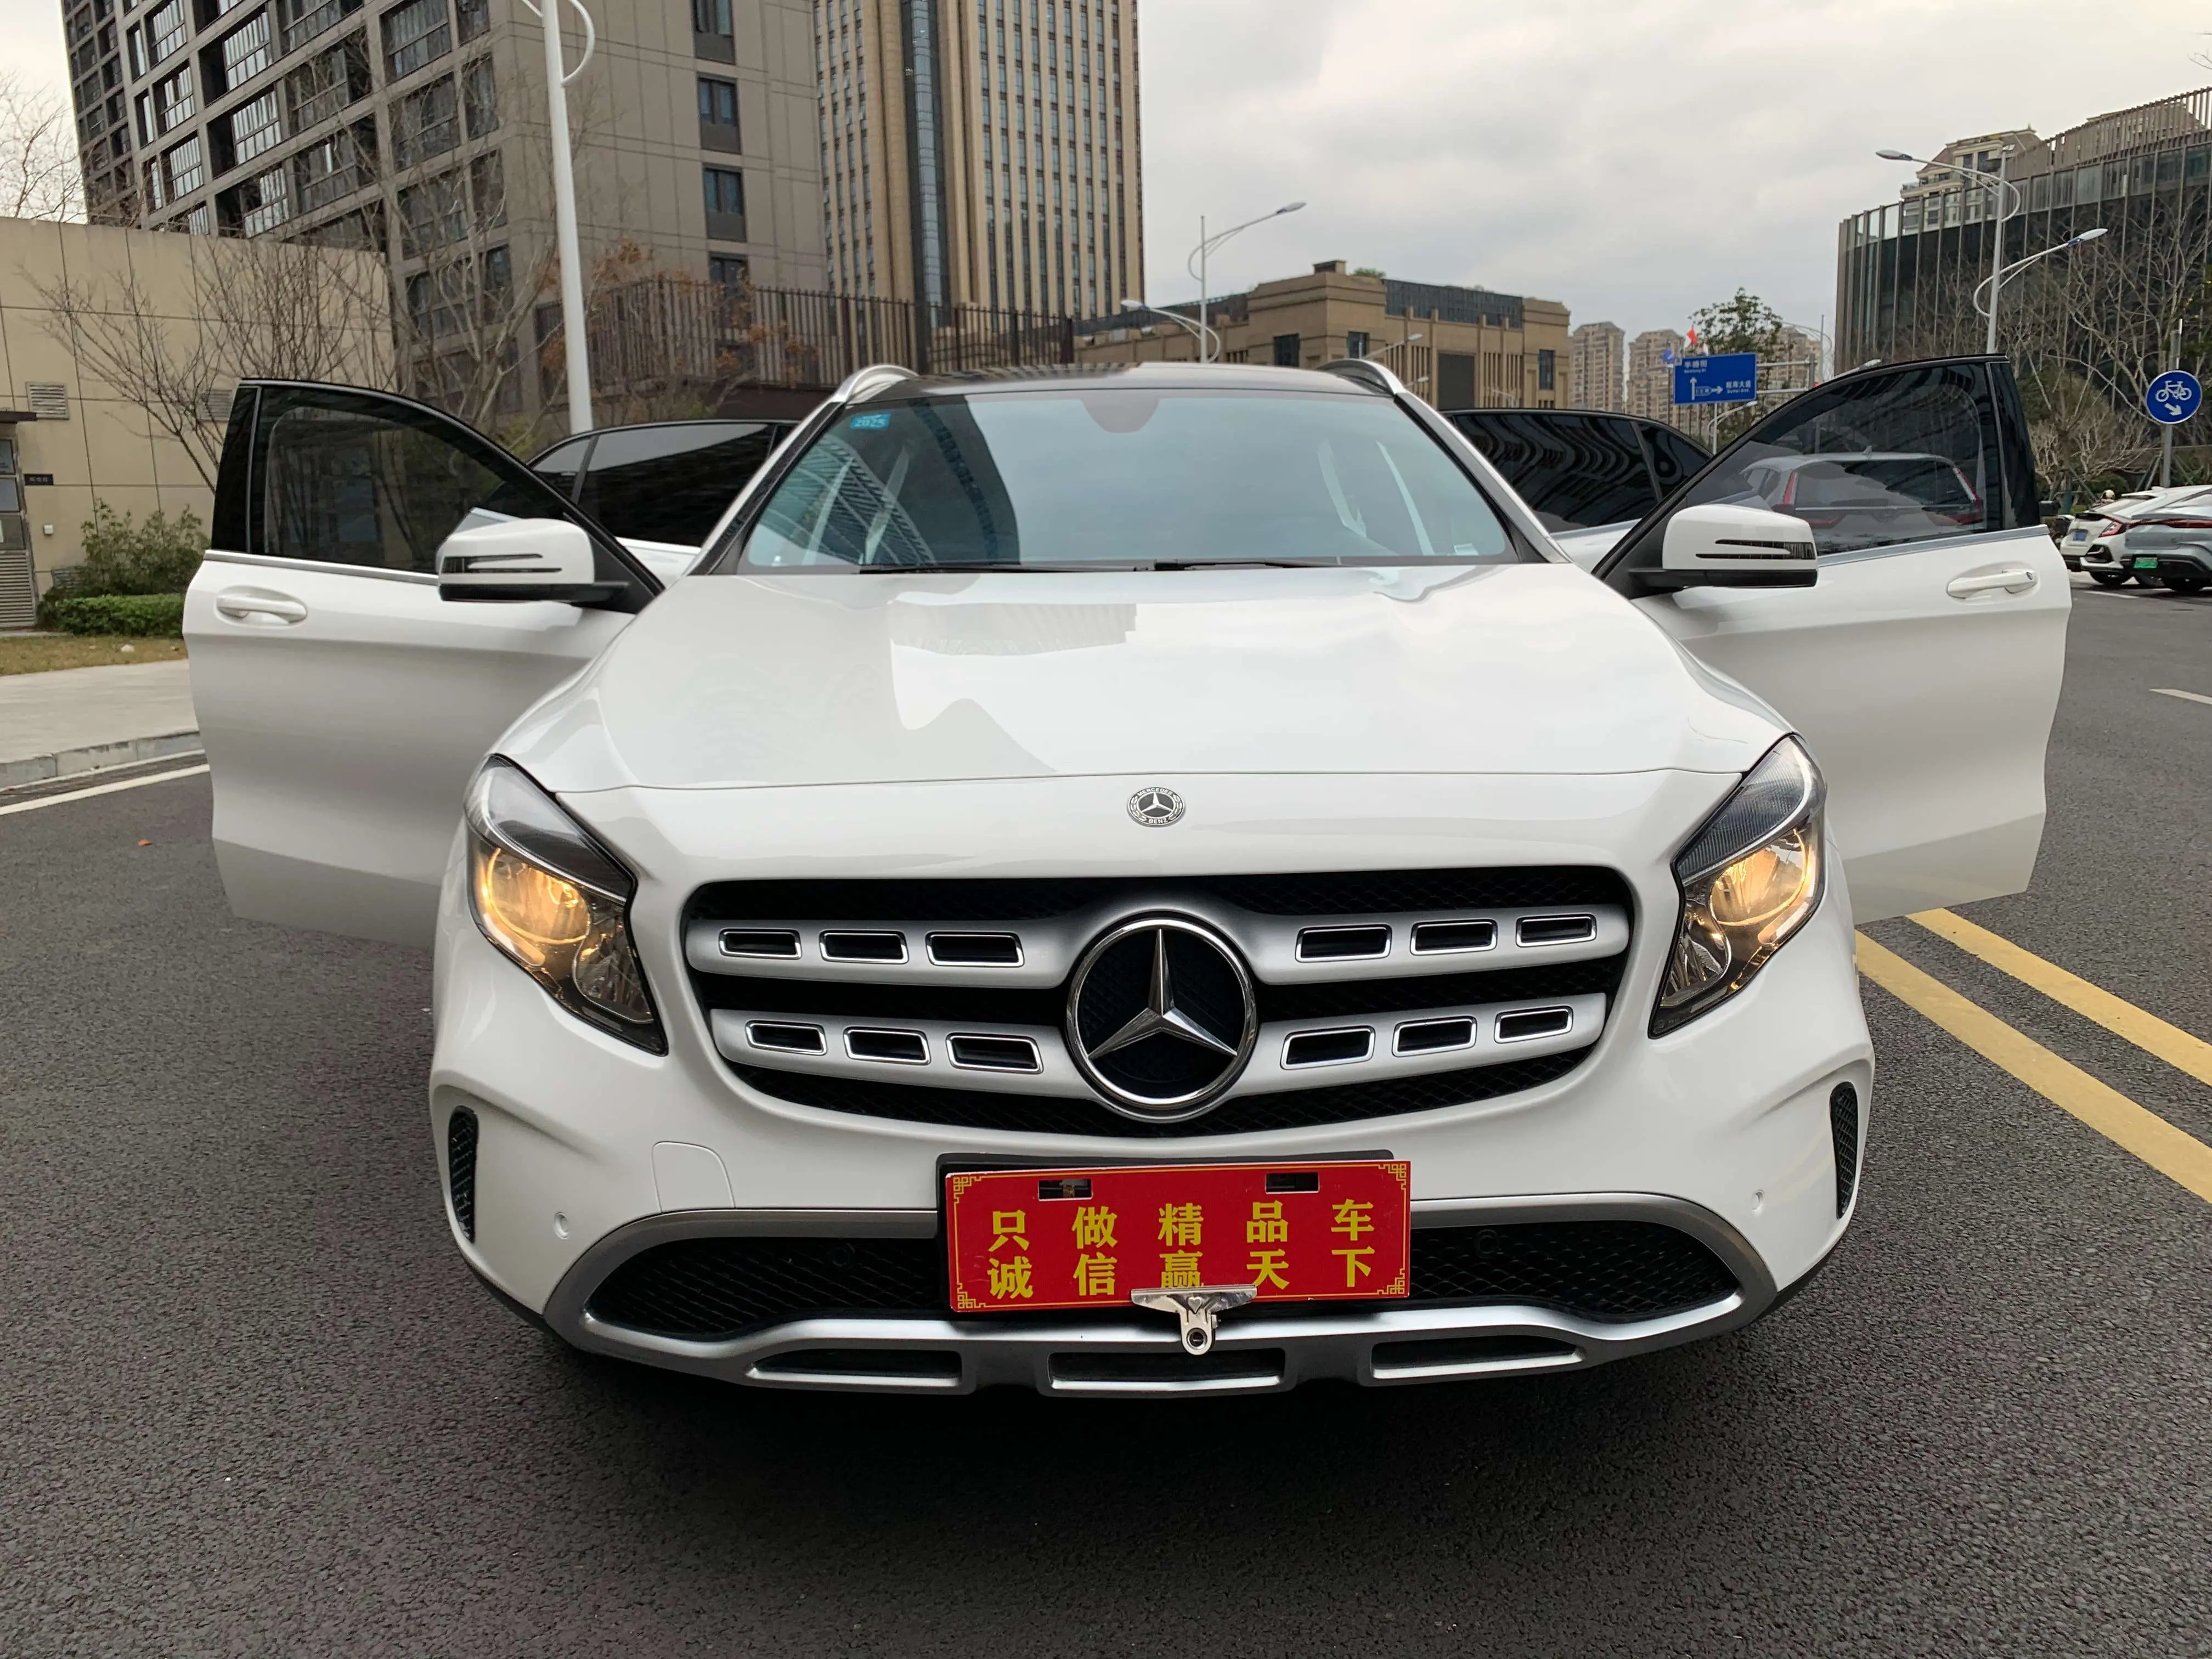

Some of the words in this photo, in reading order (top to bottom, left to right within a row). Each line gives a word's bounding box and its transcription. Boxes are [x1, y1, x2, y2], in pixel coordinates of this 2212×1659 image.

[1137, 787, 1173, 796] MERCEDES
[988, 1199, 1375, 1252] 只做精品车
[988, 1246, 1375, 1299] 诚信赢天下
